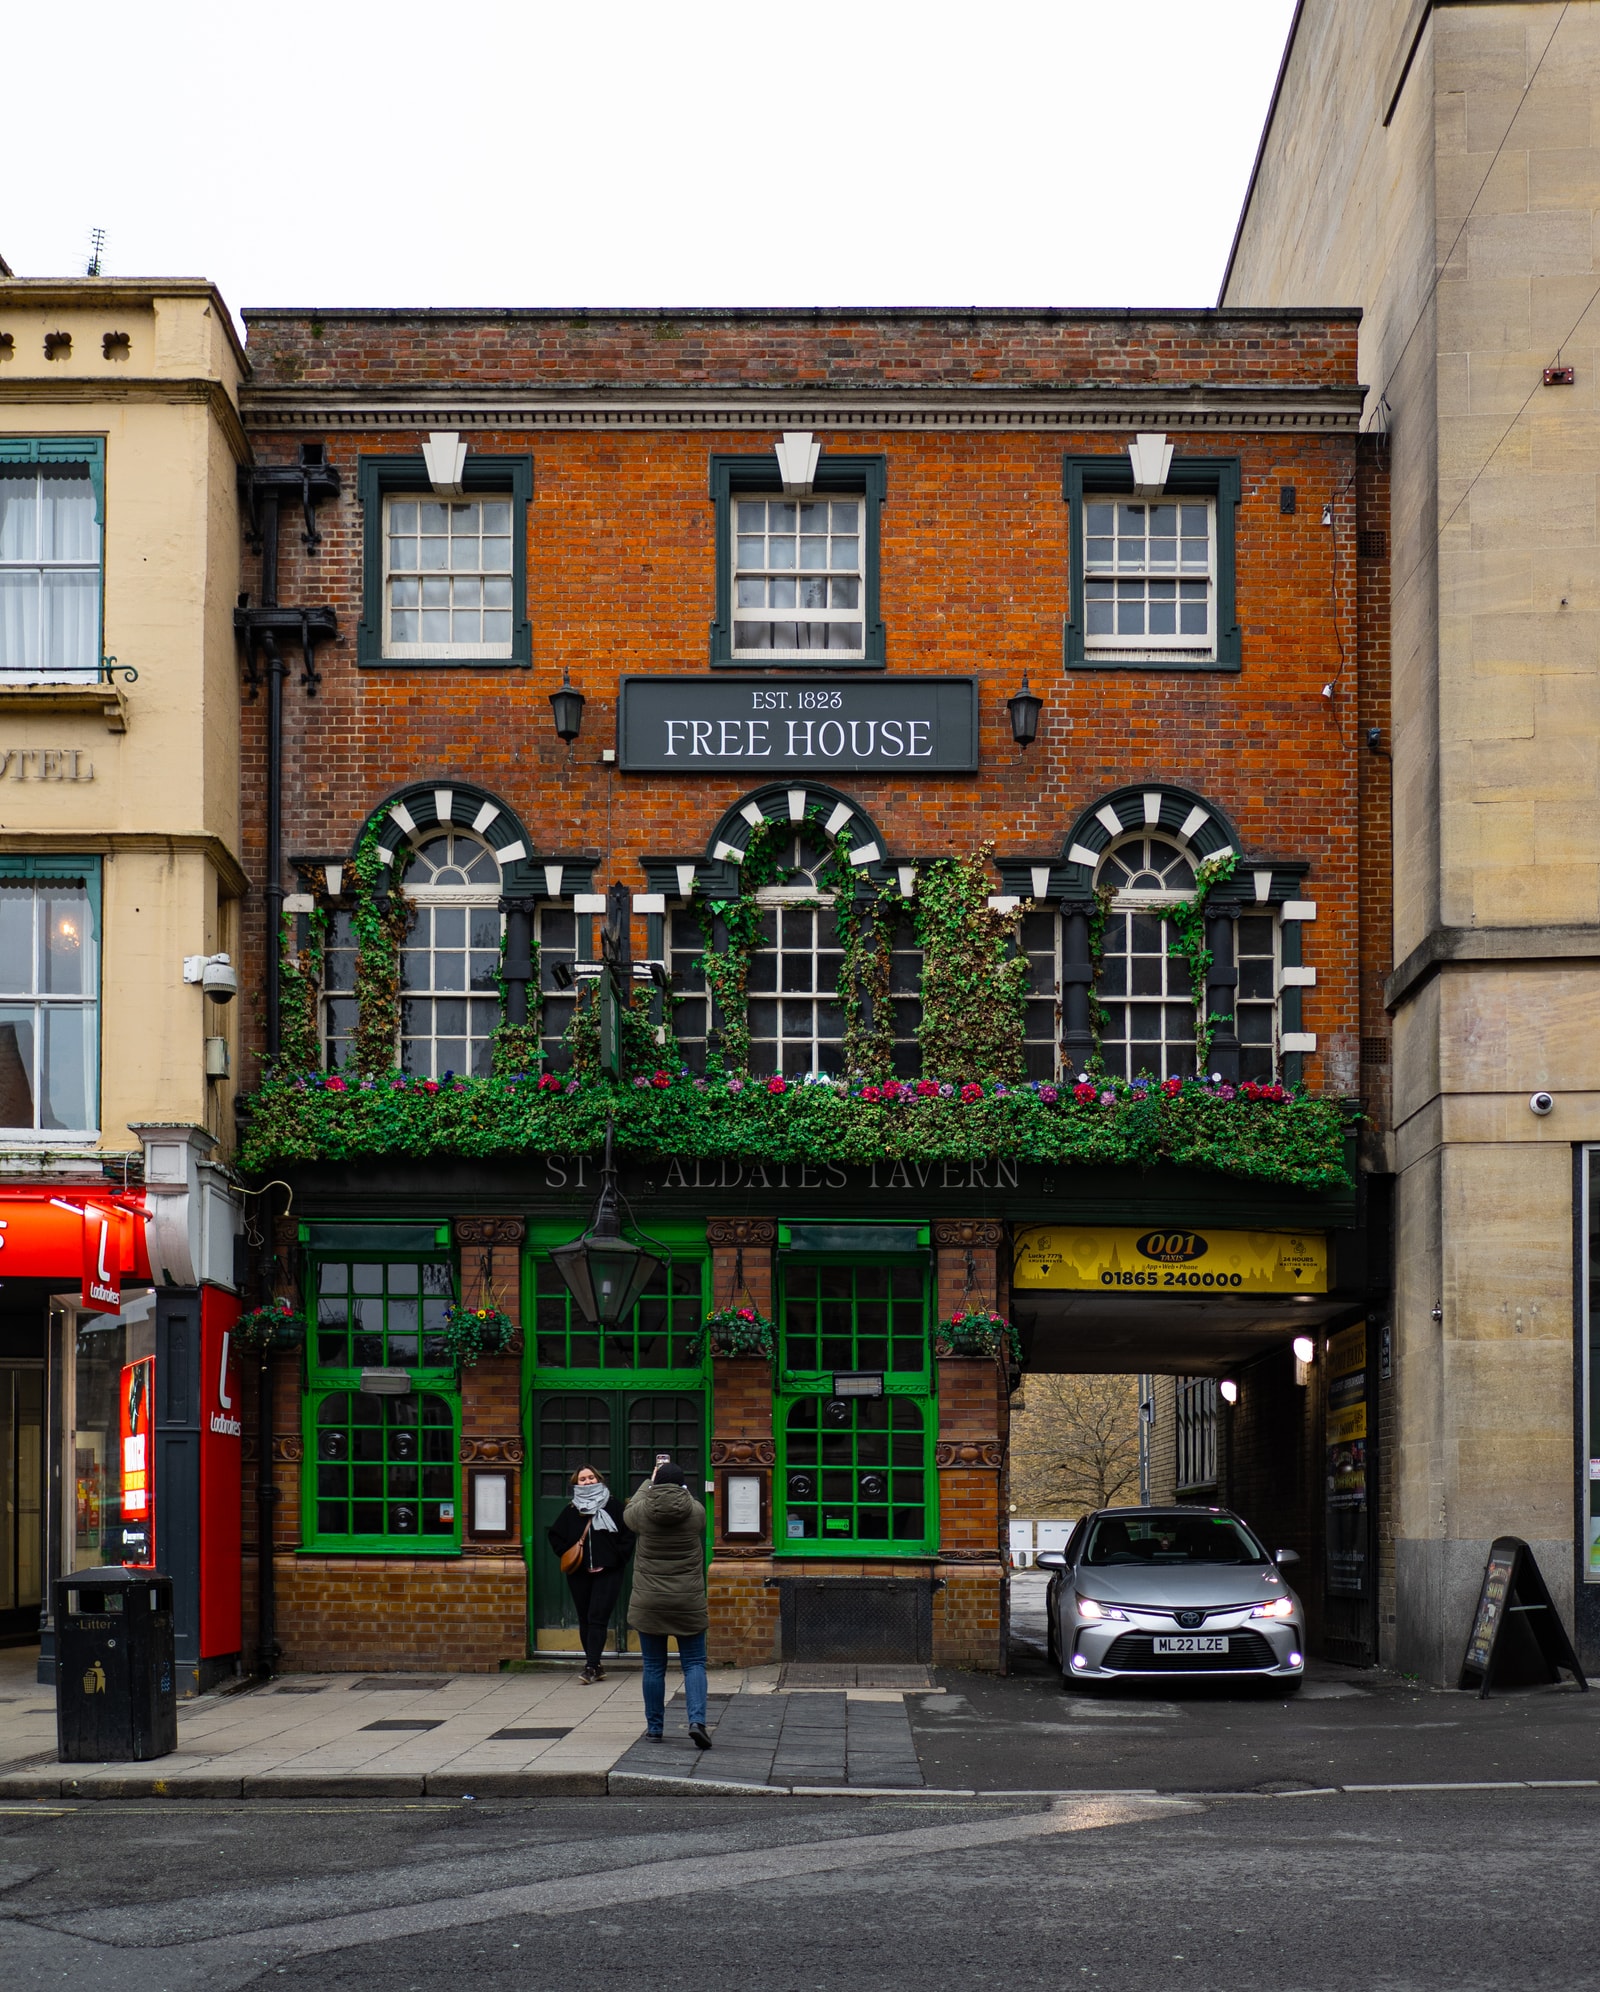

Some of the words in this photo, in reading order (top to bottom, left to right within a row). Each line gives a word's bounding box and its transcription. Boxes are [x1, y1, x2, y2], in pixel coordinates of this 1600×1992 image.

[751, 691, 792, 710] EST.
[798, 691, 843, 710] 1823
[664, 720, 772, 756] FREE
[784, 720, 934, 757] HOUSE
[545, 1154, 593, 1188] ST
[1146, 1233, 1196, 1255] 001
[1146, 1263, 1158, 1271] App
[1160, 1254, 1184, 1262] TAXIS
[1101, 1271, 1158, 1286] 01865
[1163, 1272, 1243, 1287] 240000
[90, 1281, 120, 1305] Ladbrokes
[210, 1411, 241, 1437] Ladbrokes
[79, 1619, 112, 1630] Litter
[1159, 1639, 1194, 1651] ML22
[1197, 1638, 1223, 1651] LZE
